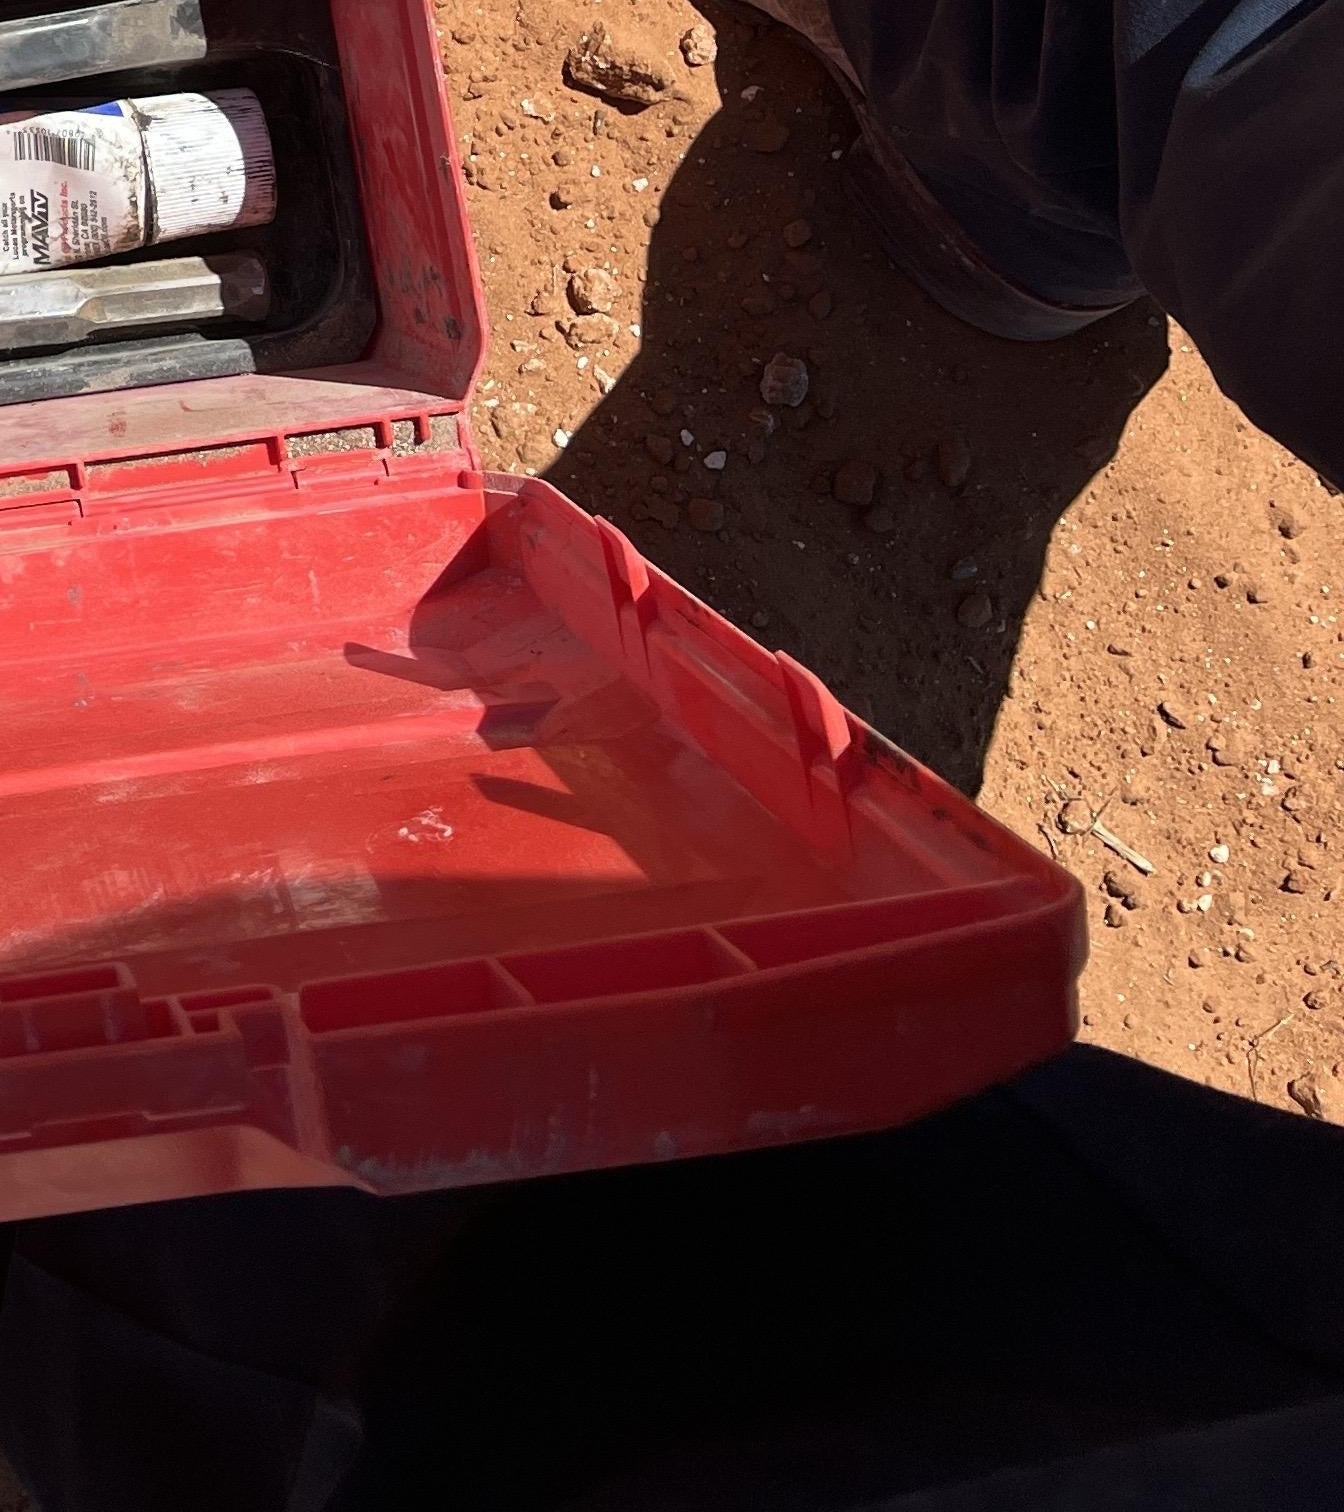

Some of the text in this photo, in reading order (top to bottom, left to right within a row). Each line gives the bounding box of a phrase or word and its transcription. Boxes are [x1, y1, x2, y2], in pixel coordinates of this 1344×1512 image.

[60, 181, 68, 197] Inc.
[19, 196, 25, 204] on
[9, 193, 17, 235] Motorsports
[71, 212, 80, 245] Sheridan
[81, 229, 89, 239] CA
